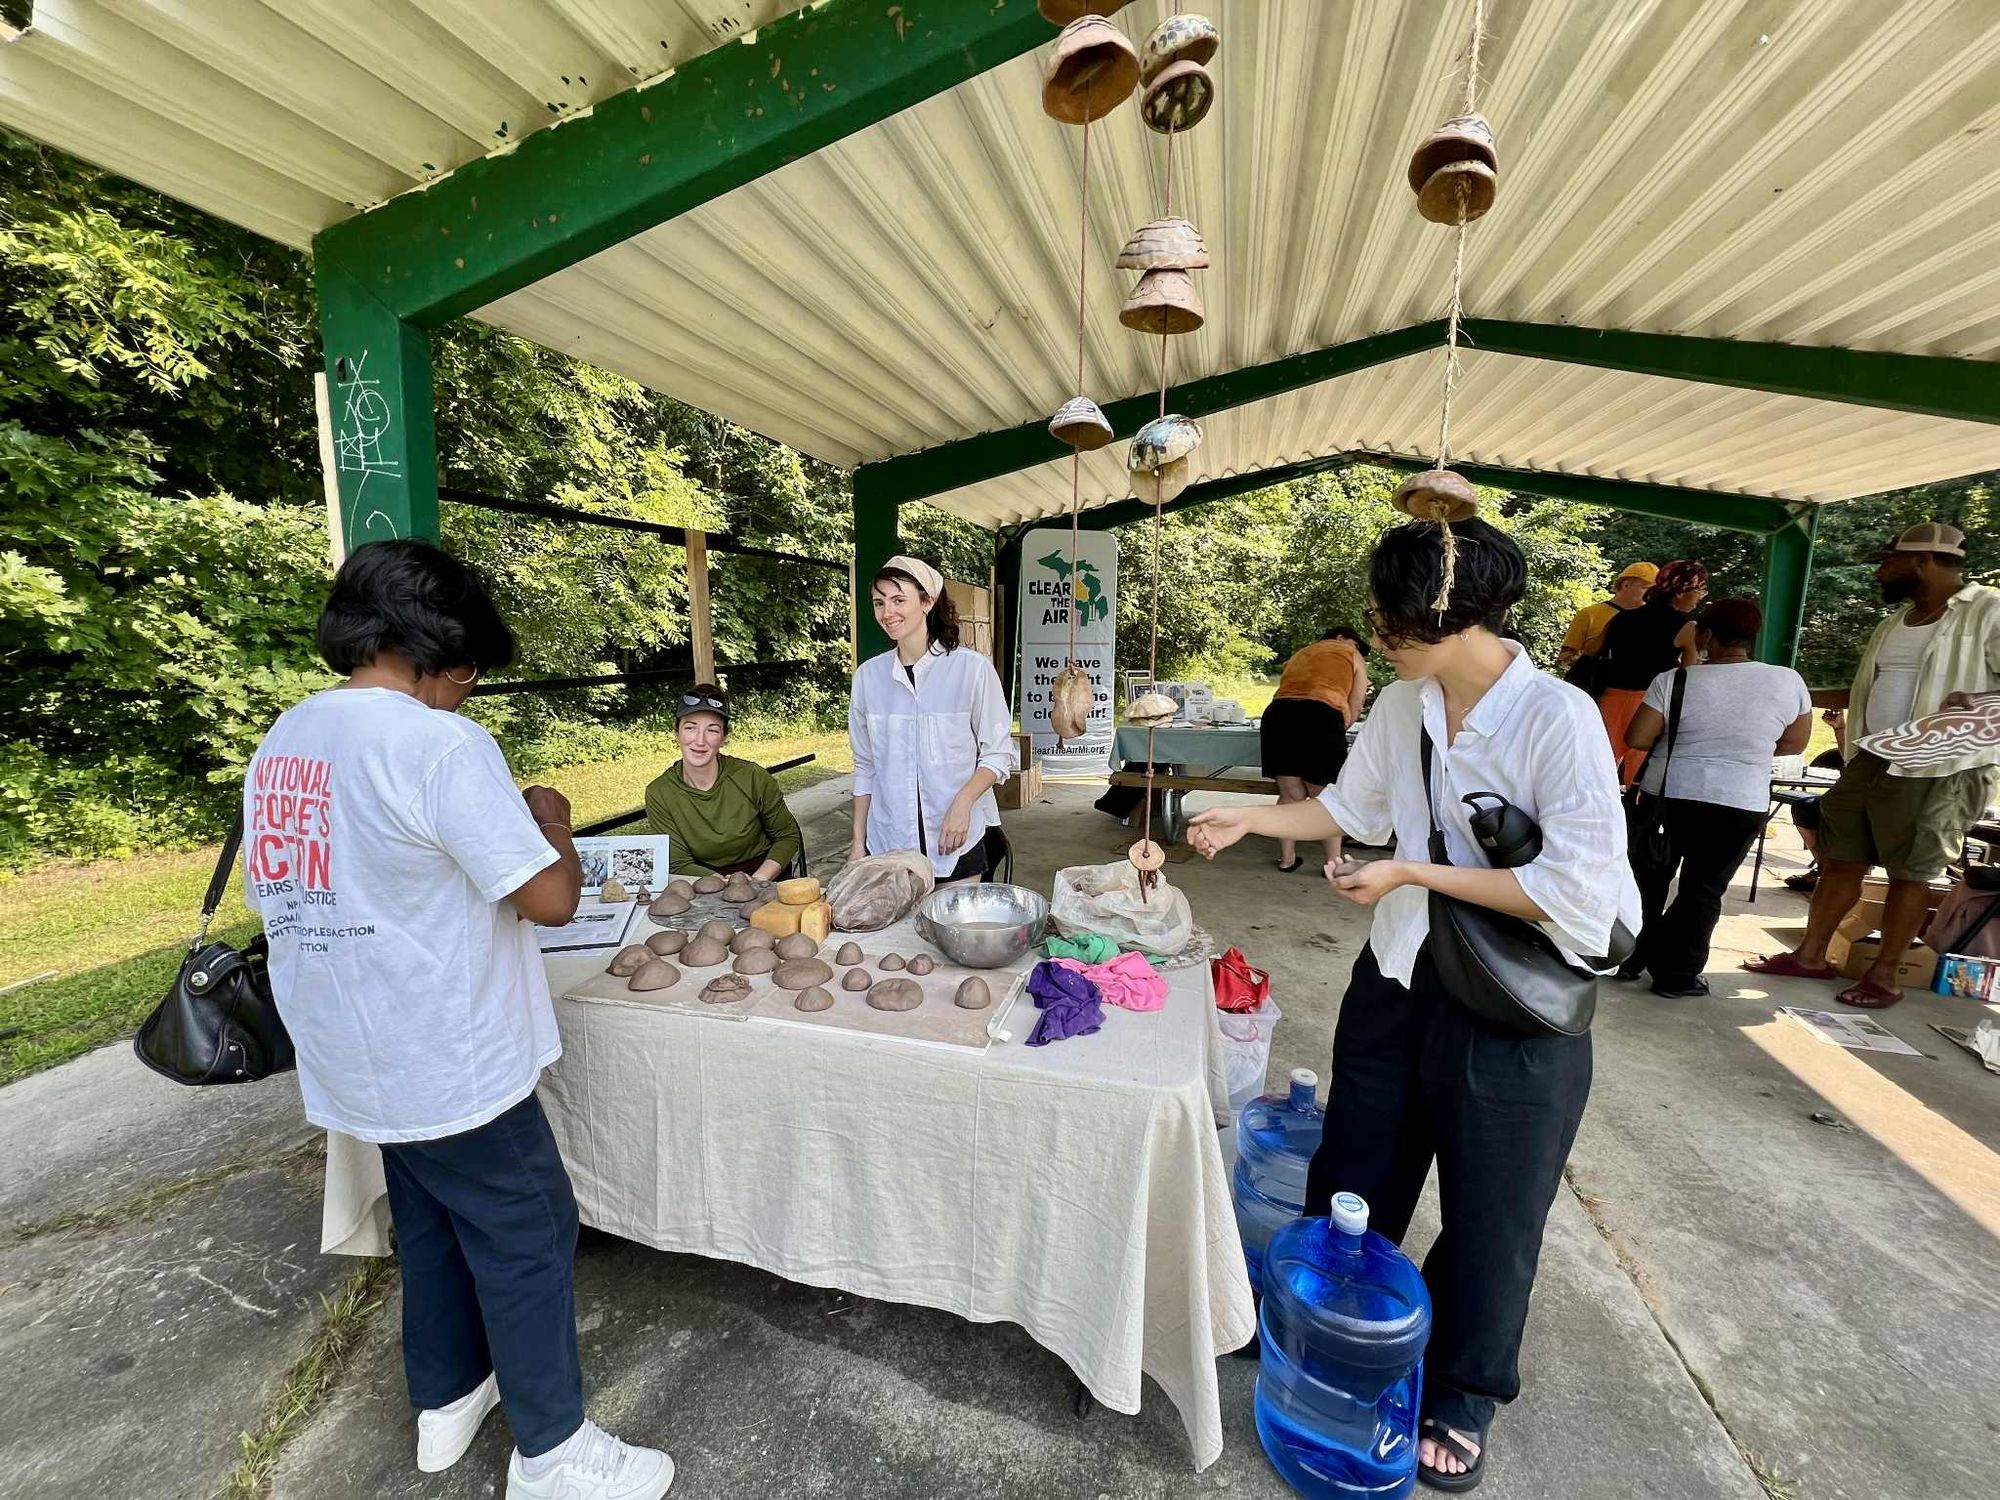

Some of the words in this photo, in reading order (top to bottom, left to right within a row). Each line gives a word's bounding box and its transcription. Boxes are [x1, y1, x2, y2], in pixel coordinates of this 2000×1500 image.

[1029, 580, 1071, 597] CLEAR
[1051, 598, 1070, 608] THE
[1042, 609, 1069, 626] AIR
[1035, 657, 1059, 668] We
[1027, 691, 1043, 703] to
[1031, 744, 1105, 756] learTheAirMi.org
[256, 879, 294, 898] EARS
